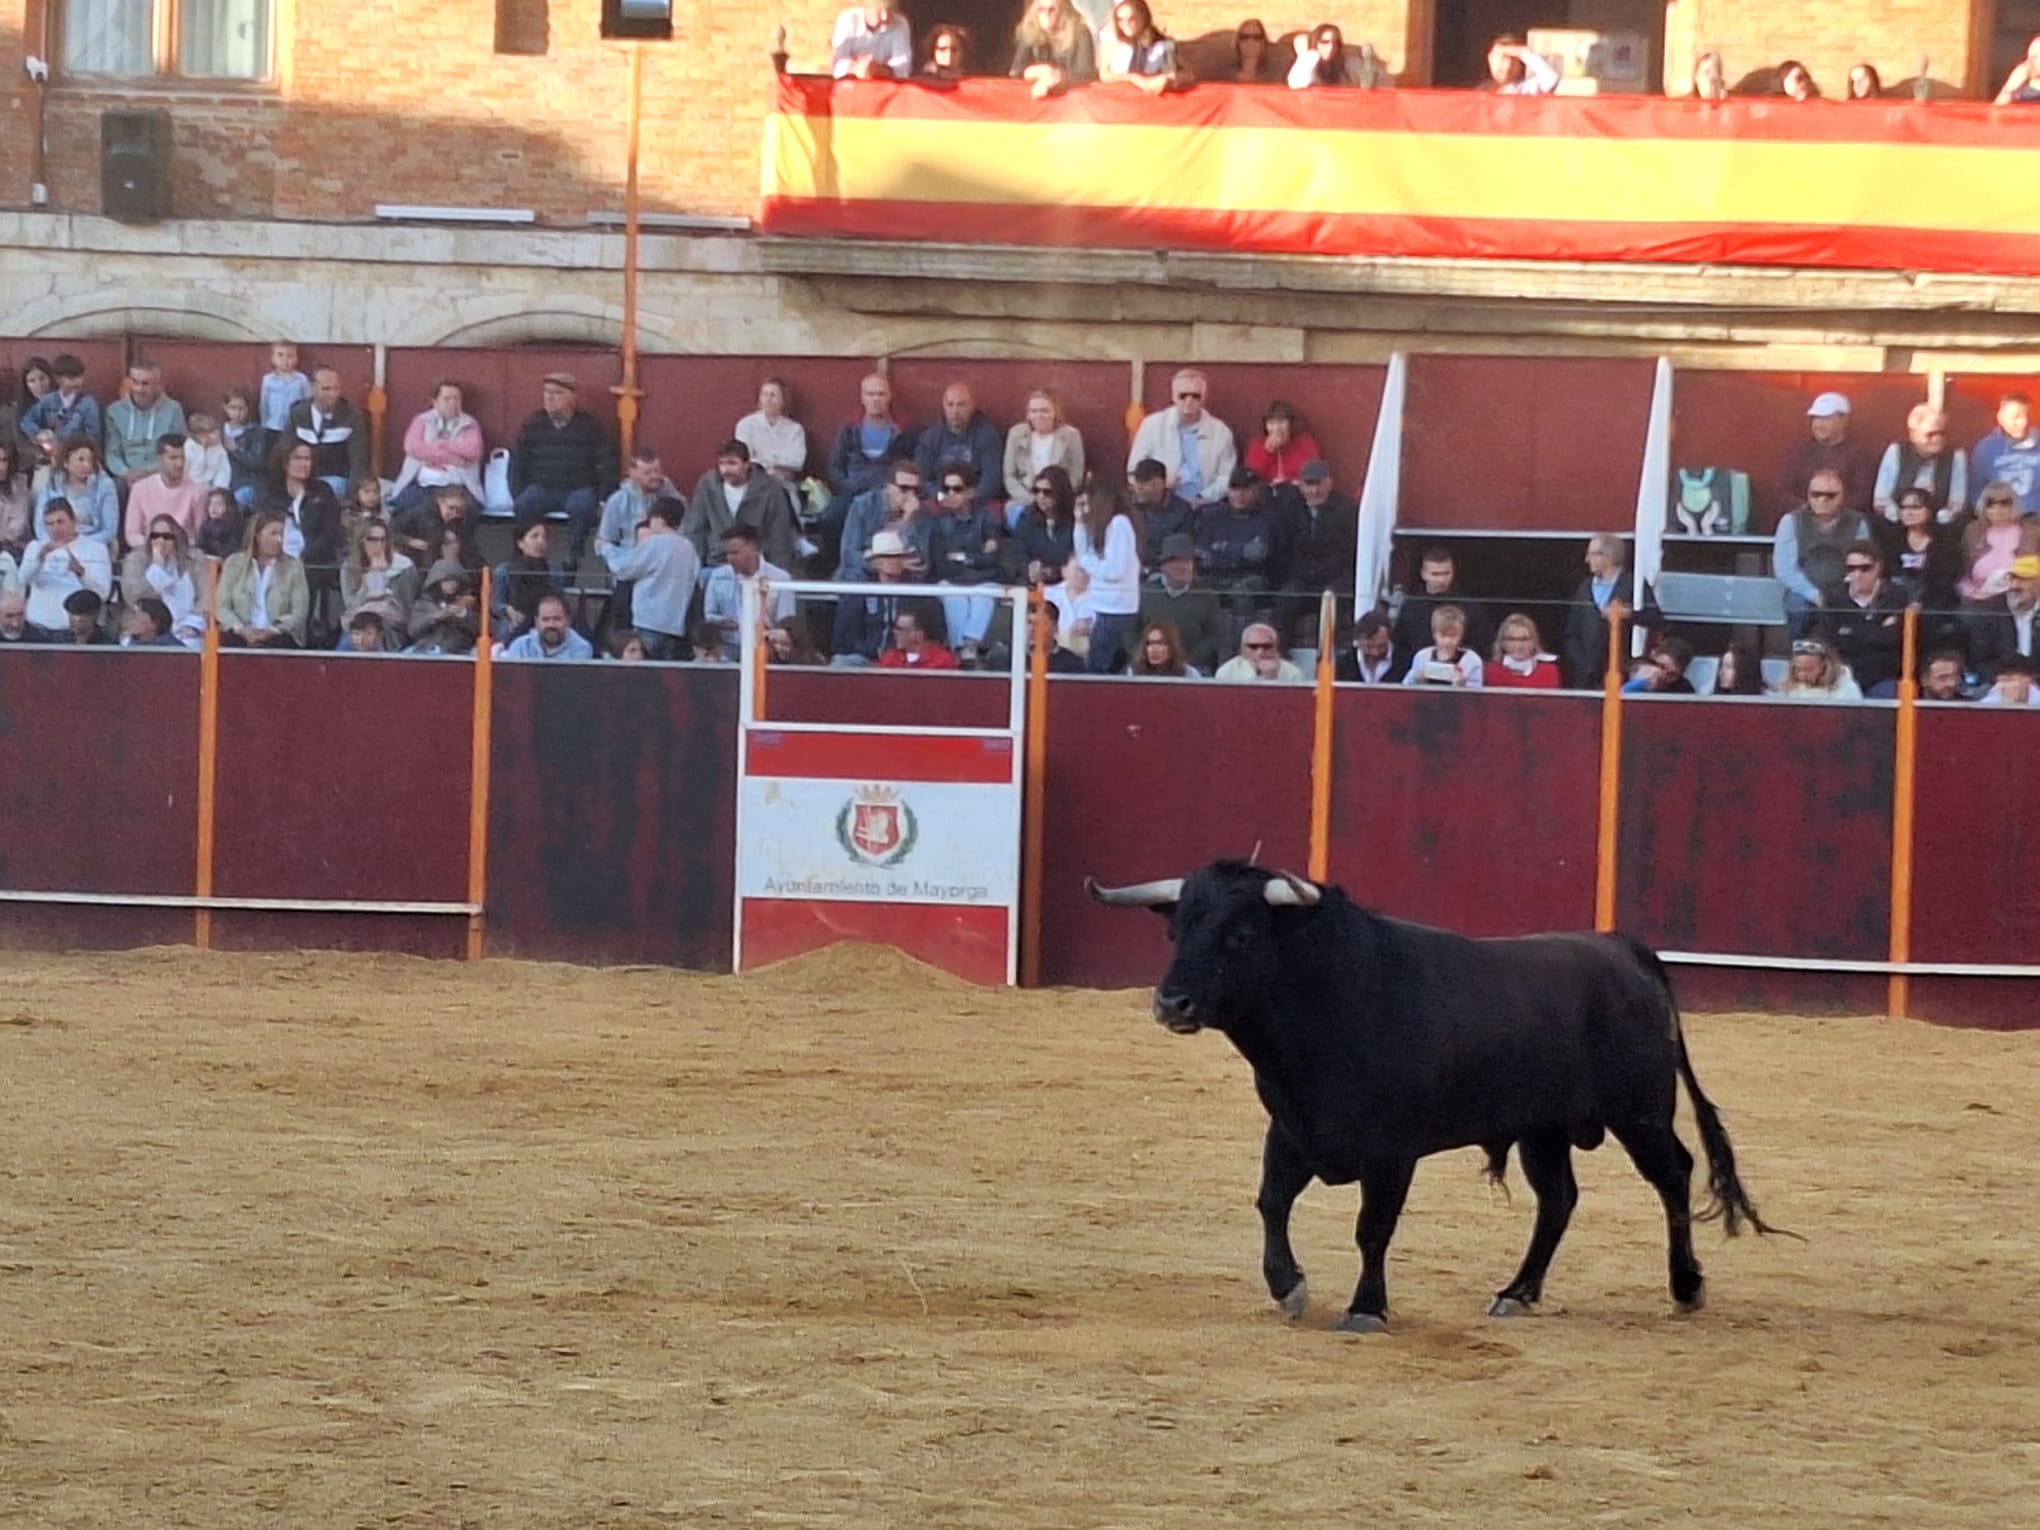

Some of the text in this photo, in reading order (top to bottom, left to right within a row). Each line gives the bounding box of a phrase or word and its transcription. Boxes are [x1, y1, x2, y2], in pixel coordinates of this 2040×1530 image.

[764, 876, 988, 900] Ayuntamiento de Mayorga
